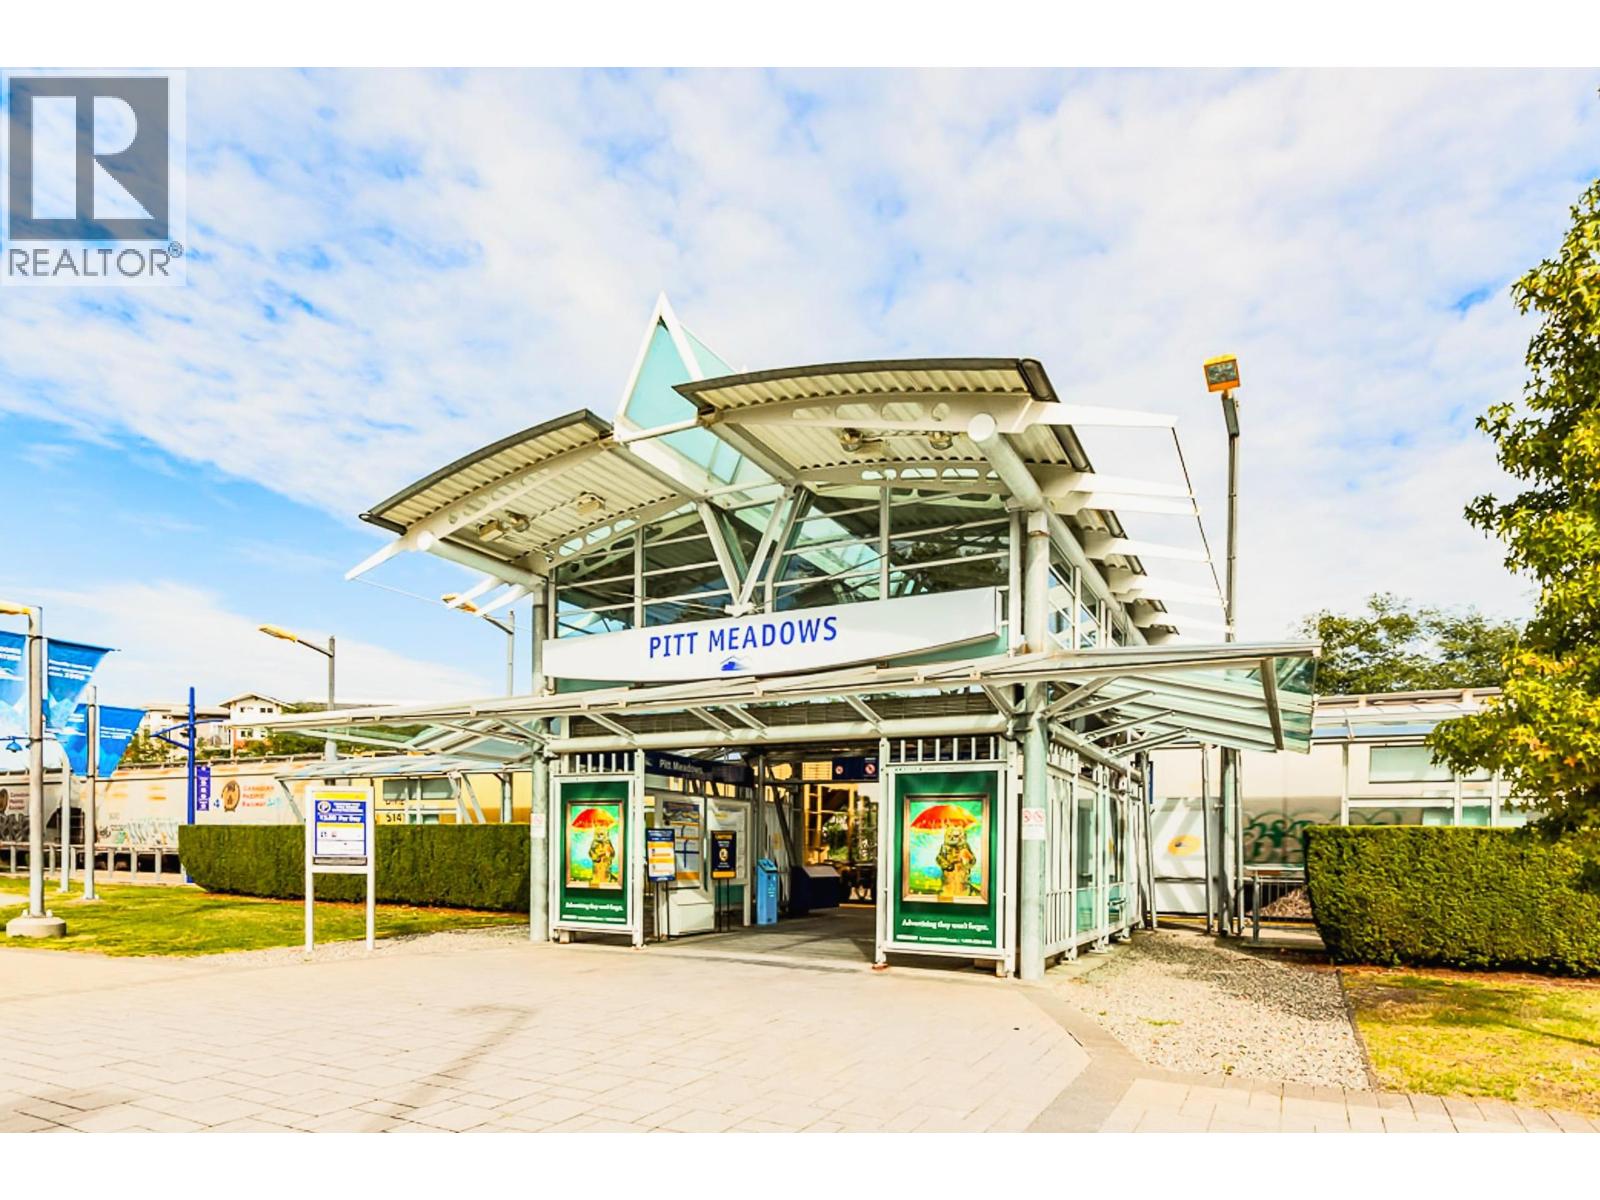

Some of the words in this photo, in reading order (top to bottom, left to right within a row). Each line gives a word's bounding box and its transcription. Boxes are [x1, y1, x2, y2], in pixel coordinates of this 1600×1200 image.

[649, 631, 698, 658] PITT
[708, 616, 838, 653] MEADOWS
[659, 759, 672, 770] Pitt
[901, 918, 937, 930] Advertising
[937, 920, 951, 931] they
